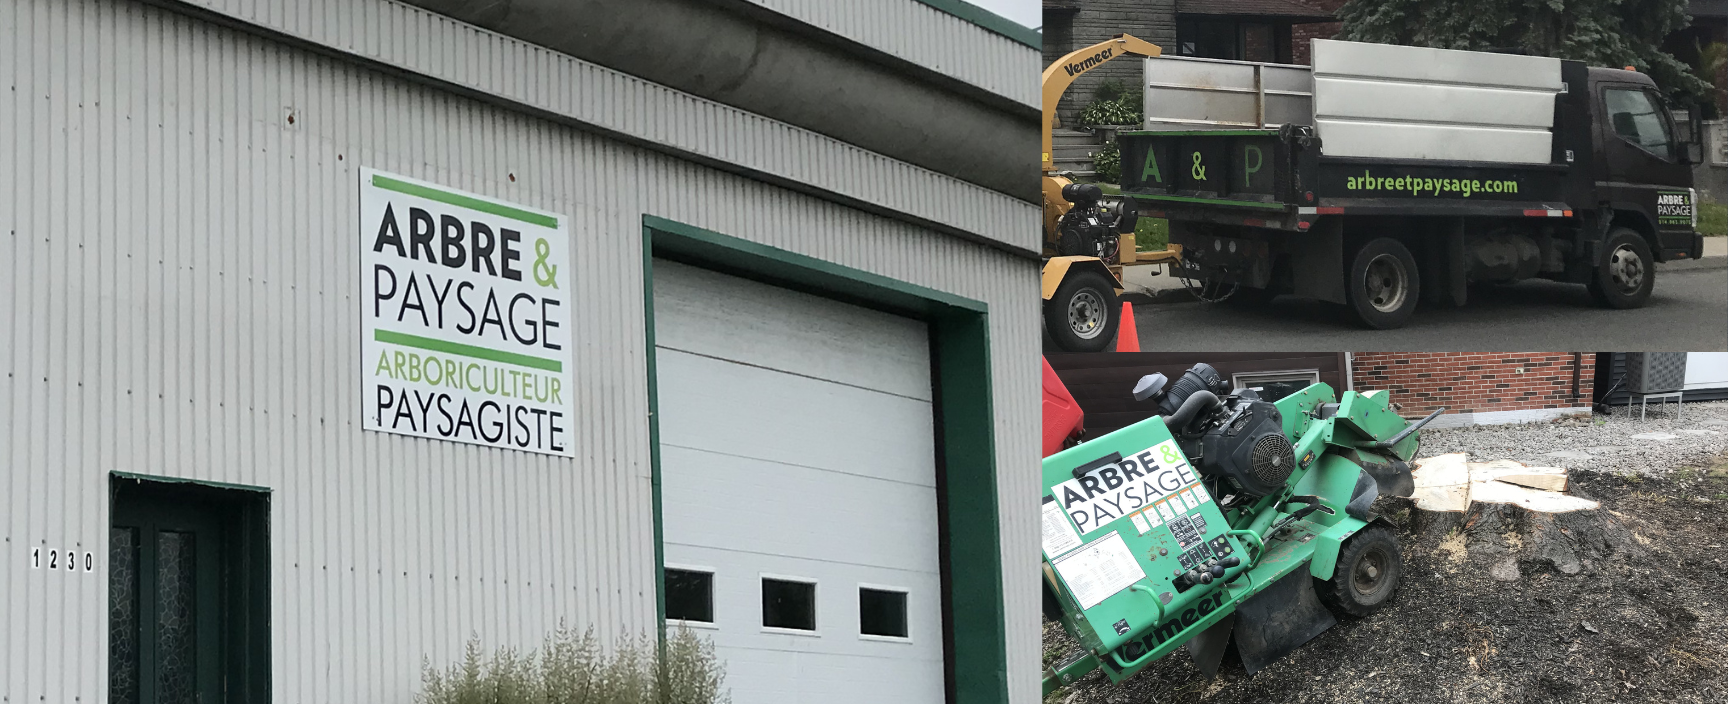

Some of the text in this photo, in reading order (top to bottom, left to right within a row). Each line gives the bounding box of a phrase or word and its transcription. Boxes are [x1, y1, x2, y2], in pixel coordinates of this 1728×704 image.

[1064, 47, 1113, 77] Vermeer
[1141, 144, 1263, 187] A & P
[1347, 169, 1518, 197] arbreetpaysage.com
[1658, 195, 1683, 204] ARBRE
[1658, 206, 1691, 215] PAYSAGE
[373, 201, 559, 290] ARBRE &
[374, 264, 562, 351] PAYSAGE
[375, 349, 563, 405] ARBORICULTEUR
[377, 384, 564, 452] PAYSAGISTE
[1064, 451, 1160, 510] ARBRE
[1159, 445, 1182, 464] &
[1070, 463, 1196, 534] PAYSAGE
[33, 548, 92, 571] 1230
